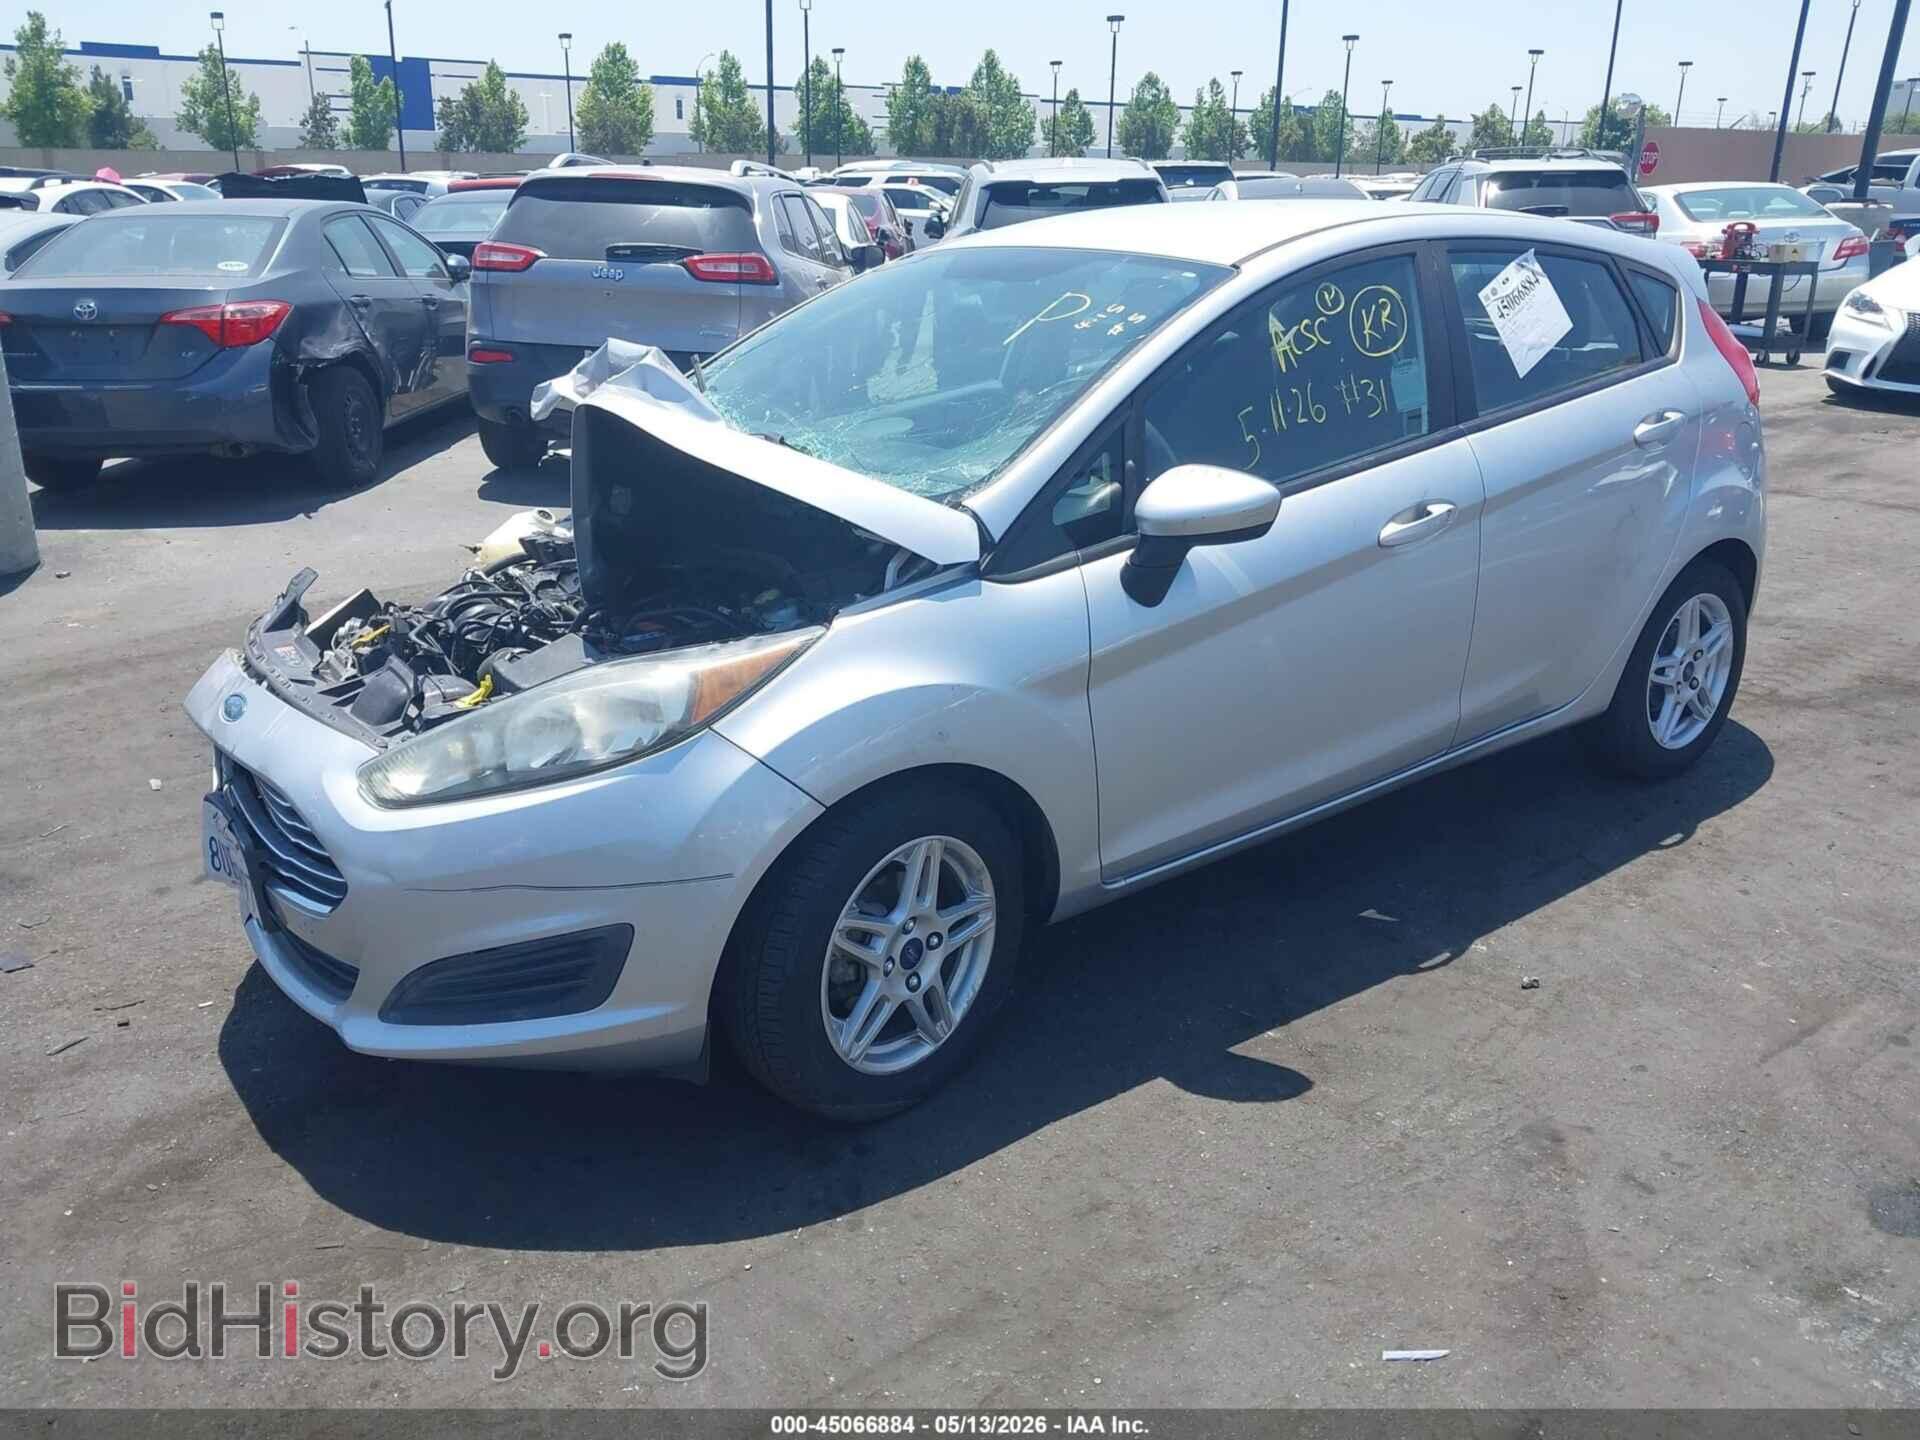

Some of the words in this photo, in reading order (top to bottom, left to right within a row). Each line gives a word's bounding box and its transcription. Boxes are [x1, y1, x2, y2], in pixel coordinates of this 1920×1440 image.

[1641, 151, 1658, 164] STOP
[592, 265, 624, 281] Jeep
[1002, 292, 1091, 345] P
[1358, 296, 1399, 350] KR
